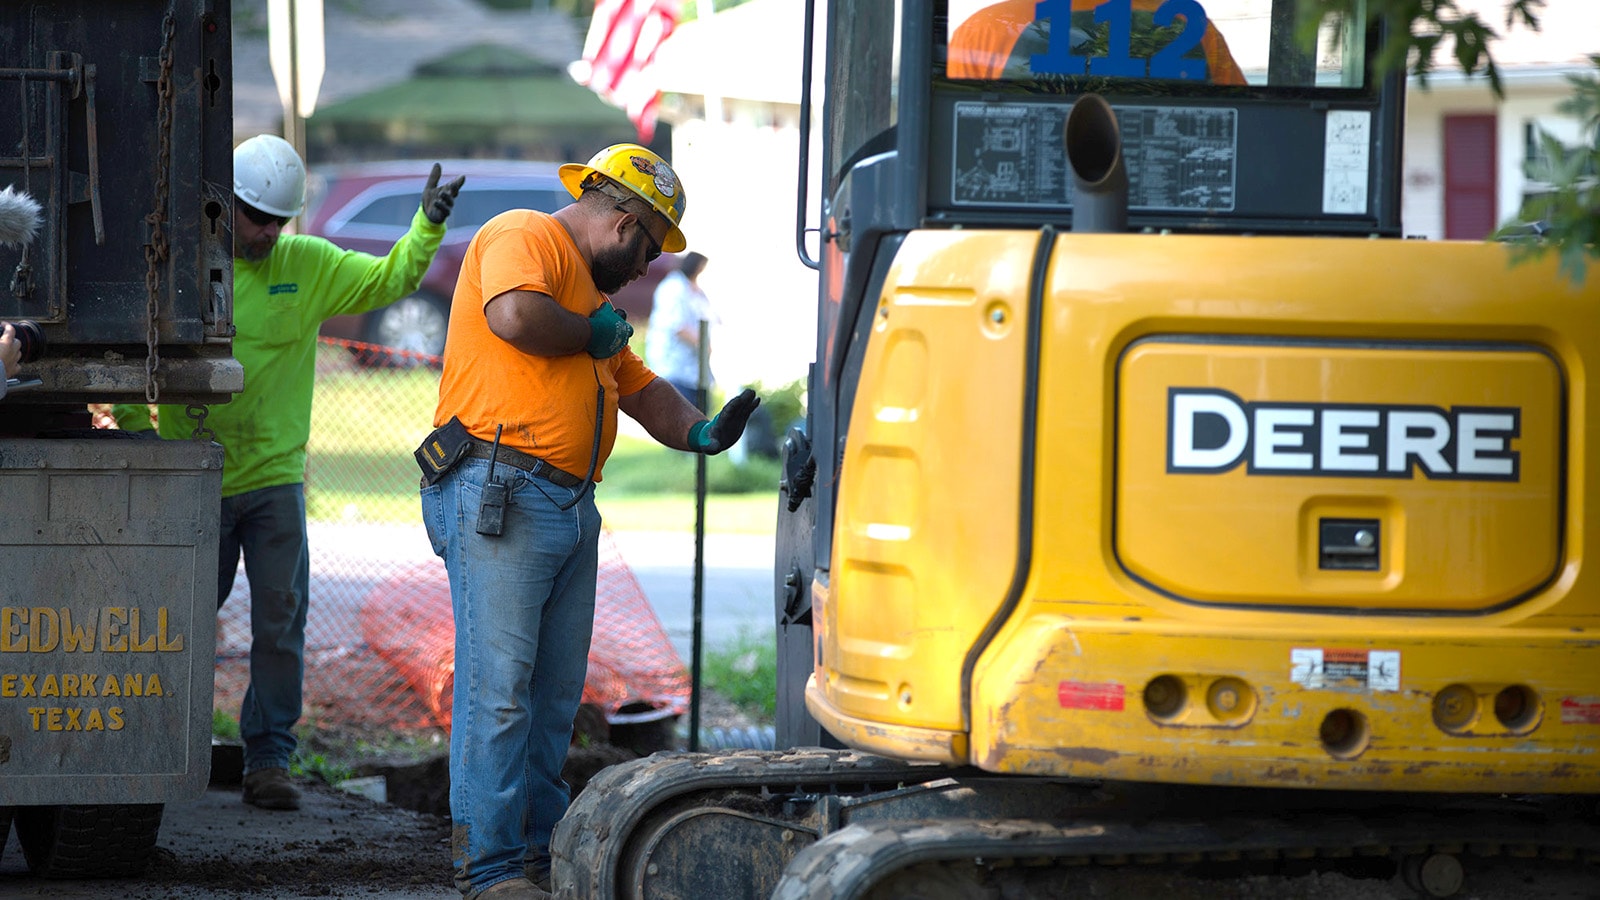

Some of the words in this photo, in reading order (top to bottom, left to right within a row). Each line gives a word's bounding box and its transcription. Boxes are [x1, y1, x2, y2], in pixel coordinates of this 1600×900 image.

[1030, 0, 1207, 80] 112
[1173, 393, 1515, 475] DEERE
[1, 606, 184, 653] EDWELL
[28, 706, 125, 732] TEXAS
